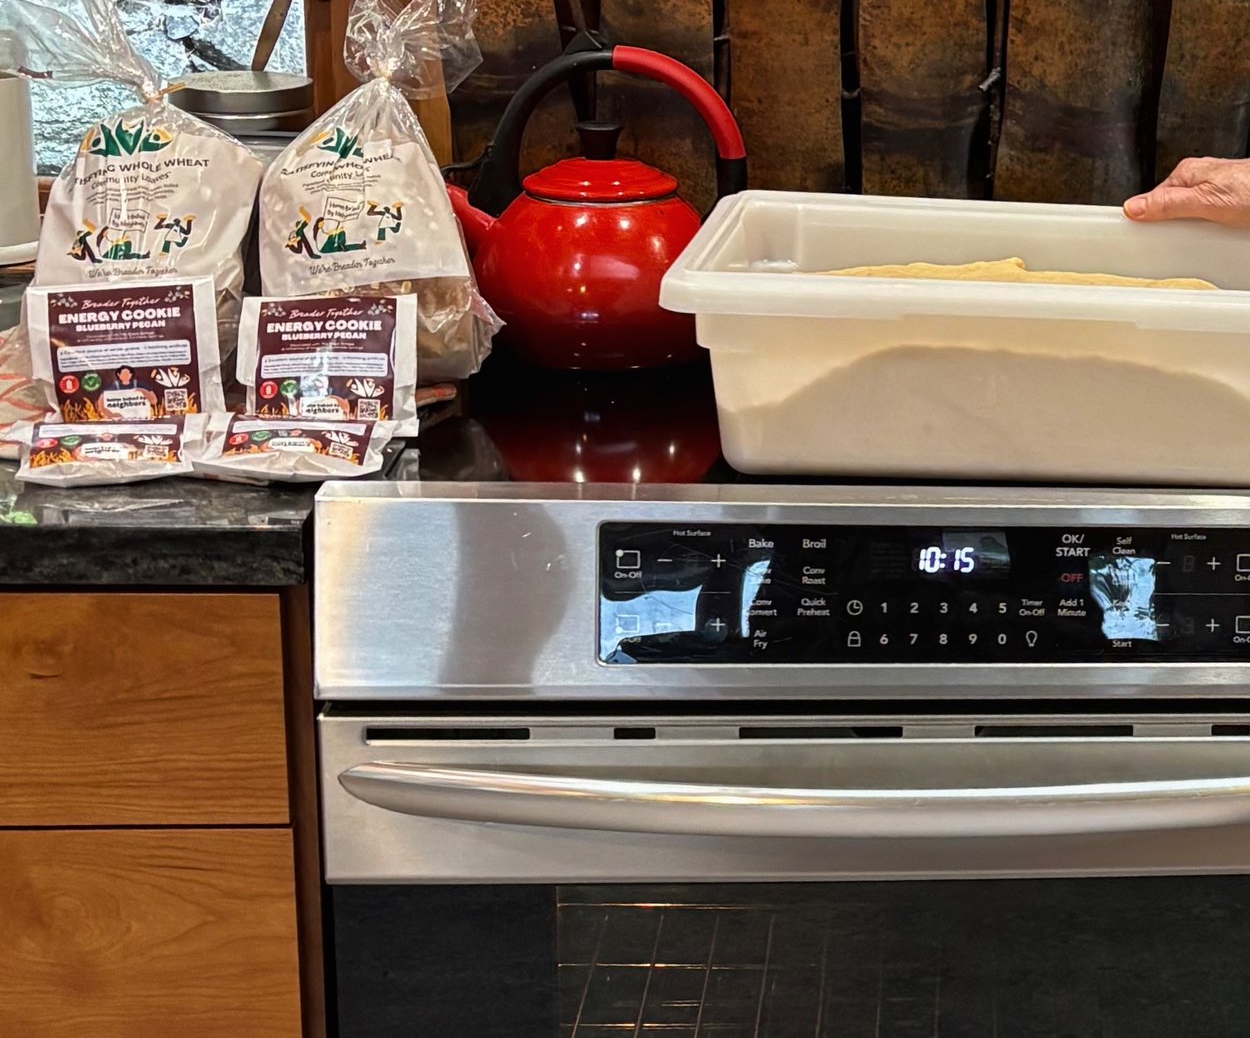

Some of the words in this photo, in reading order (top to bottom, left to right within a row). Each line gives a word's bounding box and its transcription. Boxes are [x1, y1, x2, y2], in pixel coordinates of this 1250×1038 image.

[119, 161, 161, 173] WHOLE
[163, 158, 211, 168] WHEAT
[91, 174, 139, 190] Commuity
[121, 296, 161, 308] Together
[58, 310, 119, 324] ENERGY
[121, 307, 181, 321] COOKIE
[75, 321, 131, 332] BLUEBERRY
[132, 319, 166, 329] PECAN
[266, 321, 323, 333] ENERGY
[325, 319, 382, 331] COOKIE
[281, 332, 333, 341] BLUEBERRY
[334, 331, 367, 340] PECAN
[106, 401, 147, 409] neighbors
[305, 407, 340, 415] eighbors
[748, 538, 774, 548] Bake
[802, 538, 826, 549] Broil
[1061, 533, 1085, 544] OK/
[1116, 536, 1132, 545] Self
[1055, 547, 1090, 557] START
[1112, 546, 1136, 555] Clean
[919, 546, 974, 573] 10:15
[802, 566, 825, 574] Conv
[802, 576, 826, 585] Roast
[1060, 573, 1084, 583] OFF
[801, 598, 826, 606] Quick
[1021, 598, 1043, 606] Timer
[747, 608, 777, 616] onvert
[797, 608, 830, 616] Preheat
[880, 602, 887, 614] 1
[910, 602, 919, 614] 2
[939, 602, 948, 614] 3
[968, 602, 978, 614] 4
[998, 602, 1007, 614] 5
[1018, 608, 1045, 616] On-Off
[1057, 608, 1086, 617] Minute
[753, 629, 767, 637] Air
[753, 639, 768, 650] Fry
[879, 633, 888, 645] 6
[909, 633, 918, 645] 7
[939, 633, 948, 645] 8
[968, 633, 977, 645] 9
[997, 633, 1007, 645] 0
[1112, 640, 1132, 648] Start
